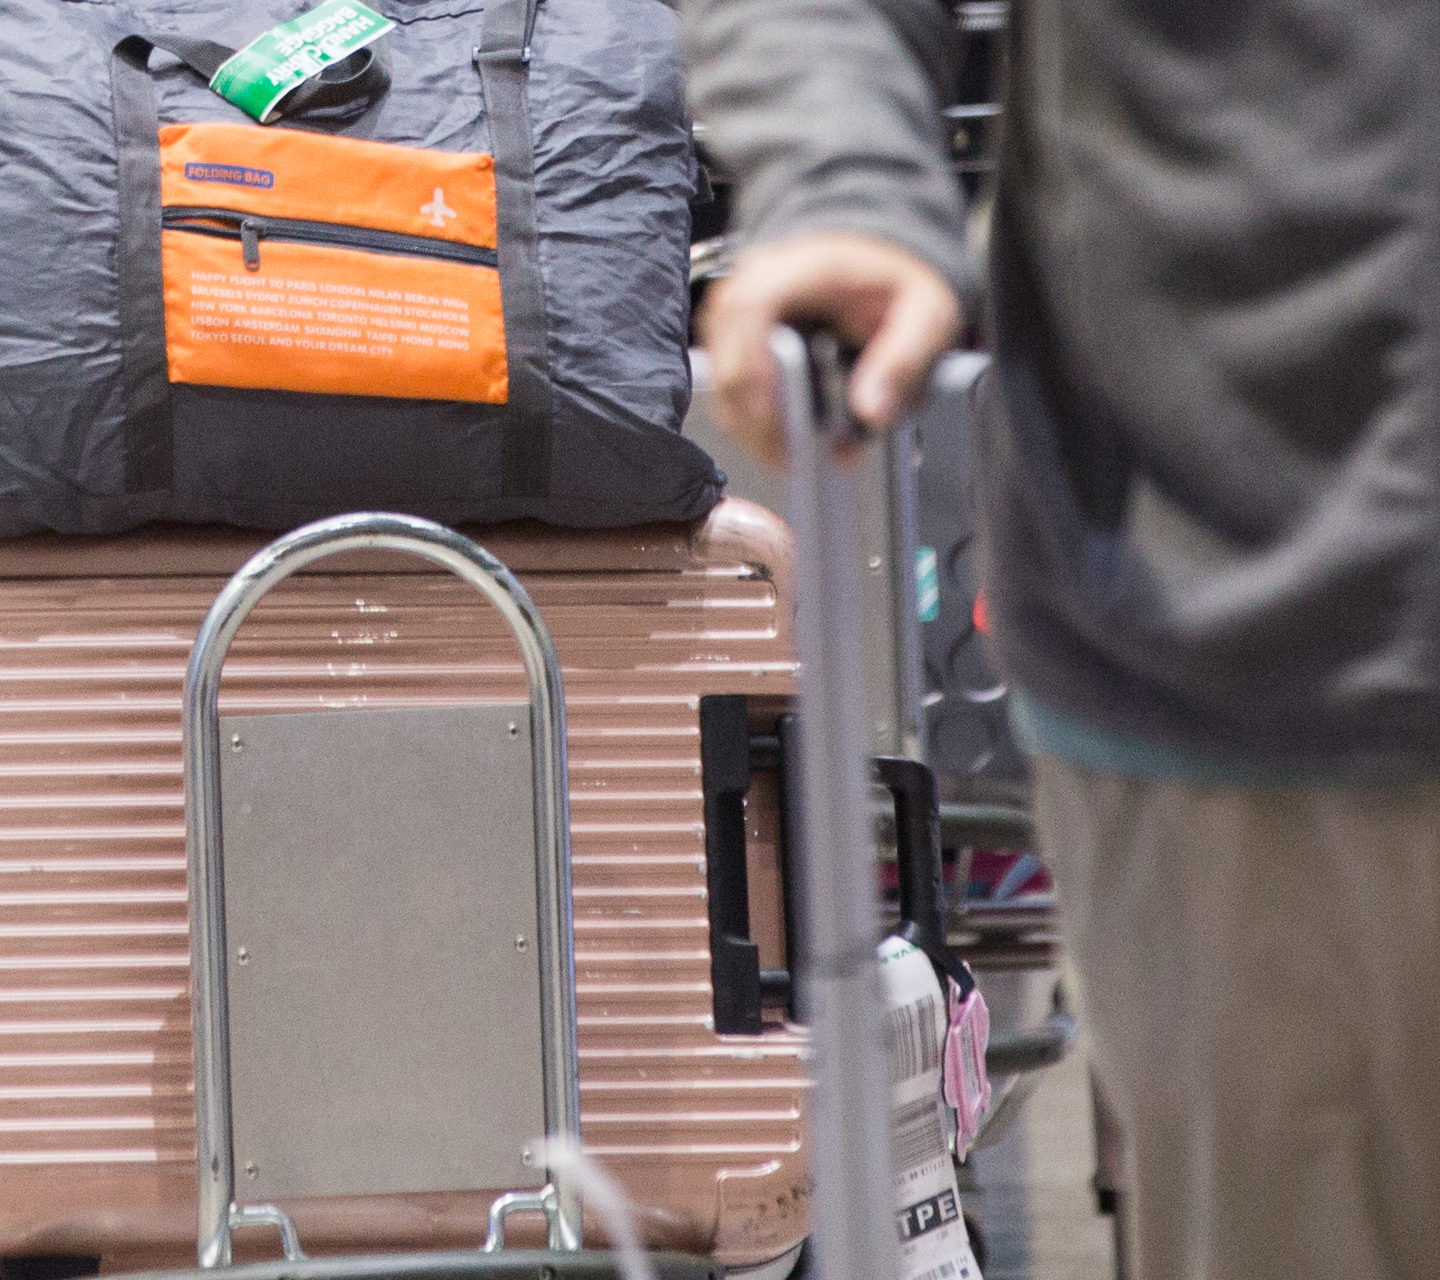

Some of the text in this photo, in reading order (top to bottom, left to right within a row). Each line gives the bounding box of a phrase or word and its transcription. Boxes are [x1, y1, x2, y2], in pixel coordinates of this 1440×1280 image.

[274, 6, 359, 57] BAGGAGE
[320, 15, 376, 55] HAND
[188, 165, 271, 185] FOLDING BAG
[191, 272, 227, 284] HAPPY
[230, 276, 266, 288] FLIGHT
[269, 279, 284, 289] TO
[287, 281, 317, 292] PARIS
[320, 283, 366, 297] LONDON
[368, 289, 402, 301] MILAN
[404, 292, 439, 306] BERLIN
[191, 286, 243, 299] BRUSSELS
[245, 291, 285, 303] SYDNEY
[330, 299, 403, 315] COPENHAGEN
[404, 307, 469, 323] STOCKHOLM
[191, 301, 470, 337] NEW YORK BARCELONA TORONTO HELSINKI MOSCOW
[191, 316, 469, 351] LISBON AMSTERDAM SHANGHAI TAIPEI HONG KONG
[190, 330, 393, 357] TOKYO SEOUL AND YOUR DREAM CITY
[898, 1195, 957, 1237] TPE
